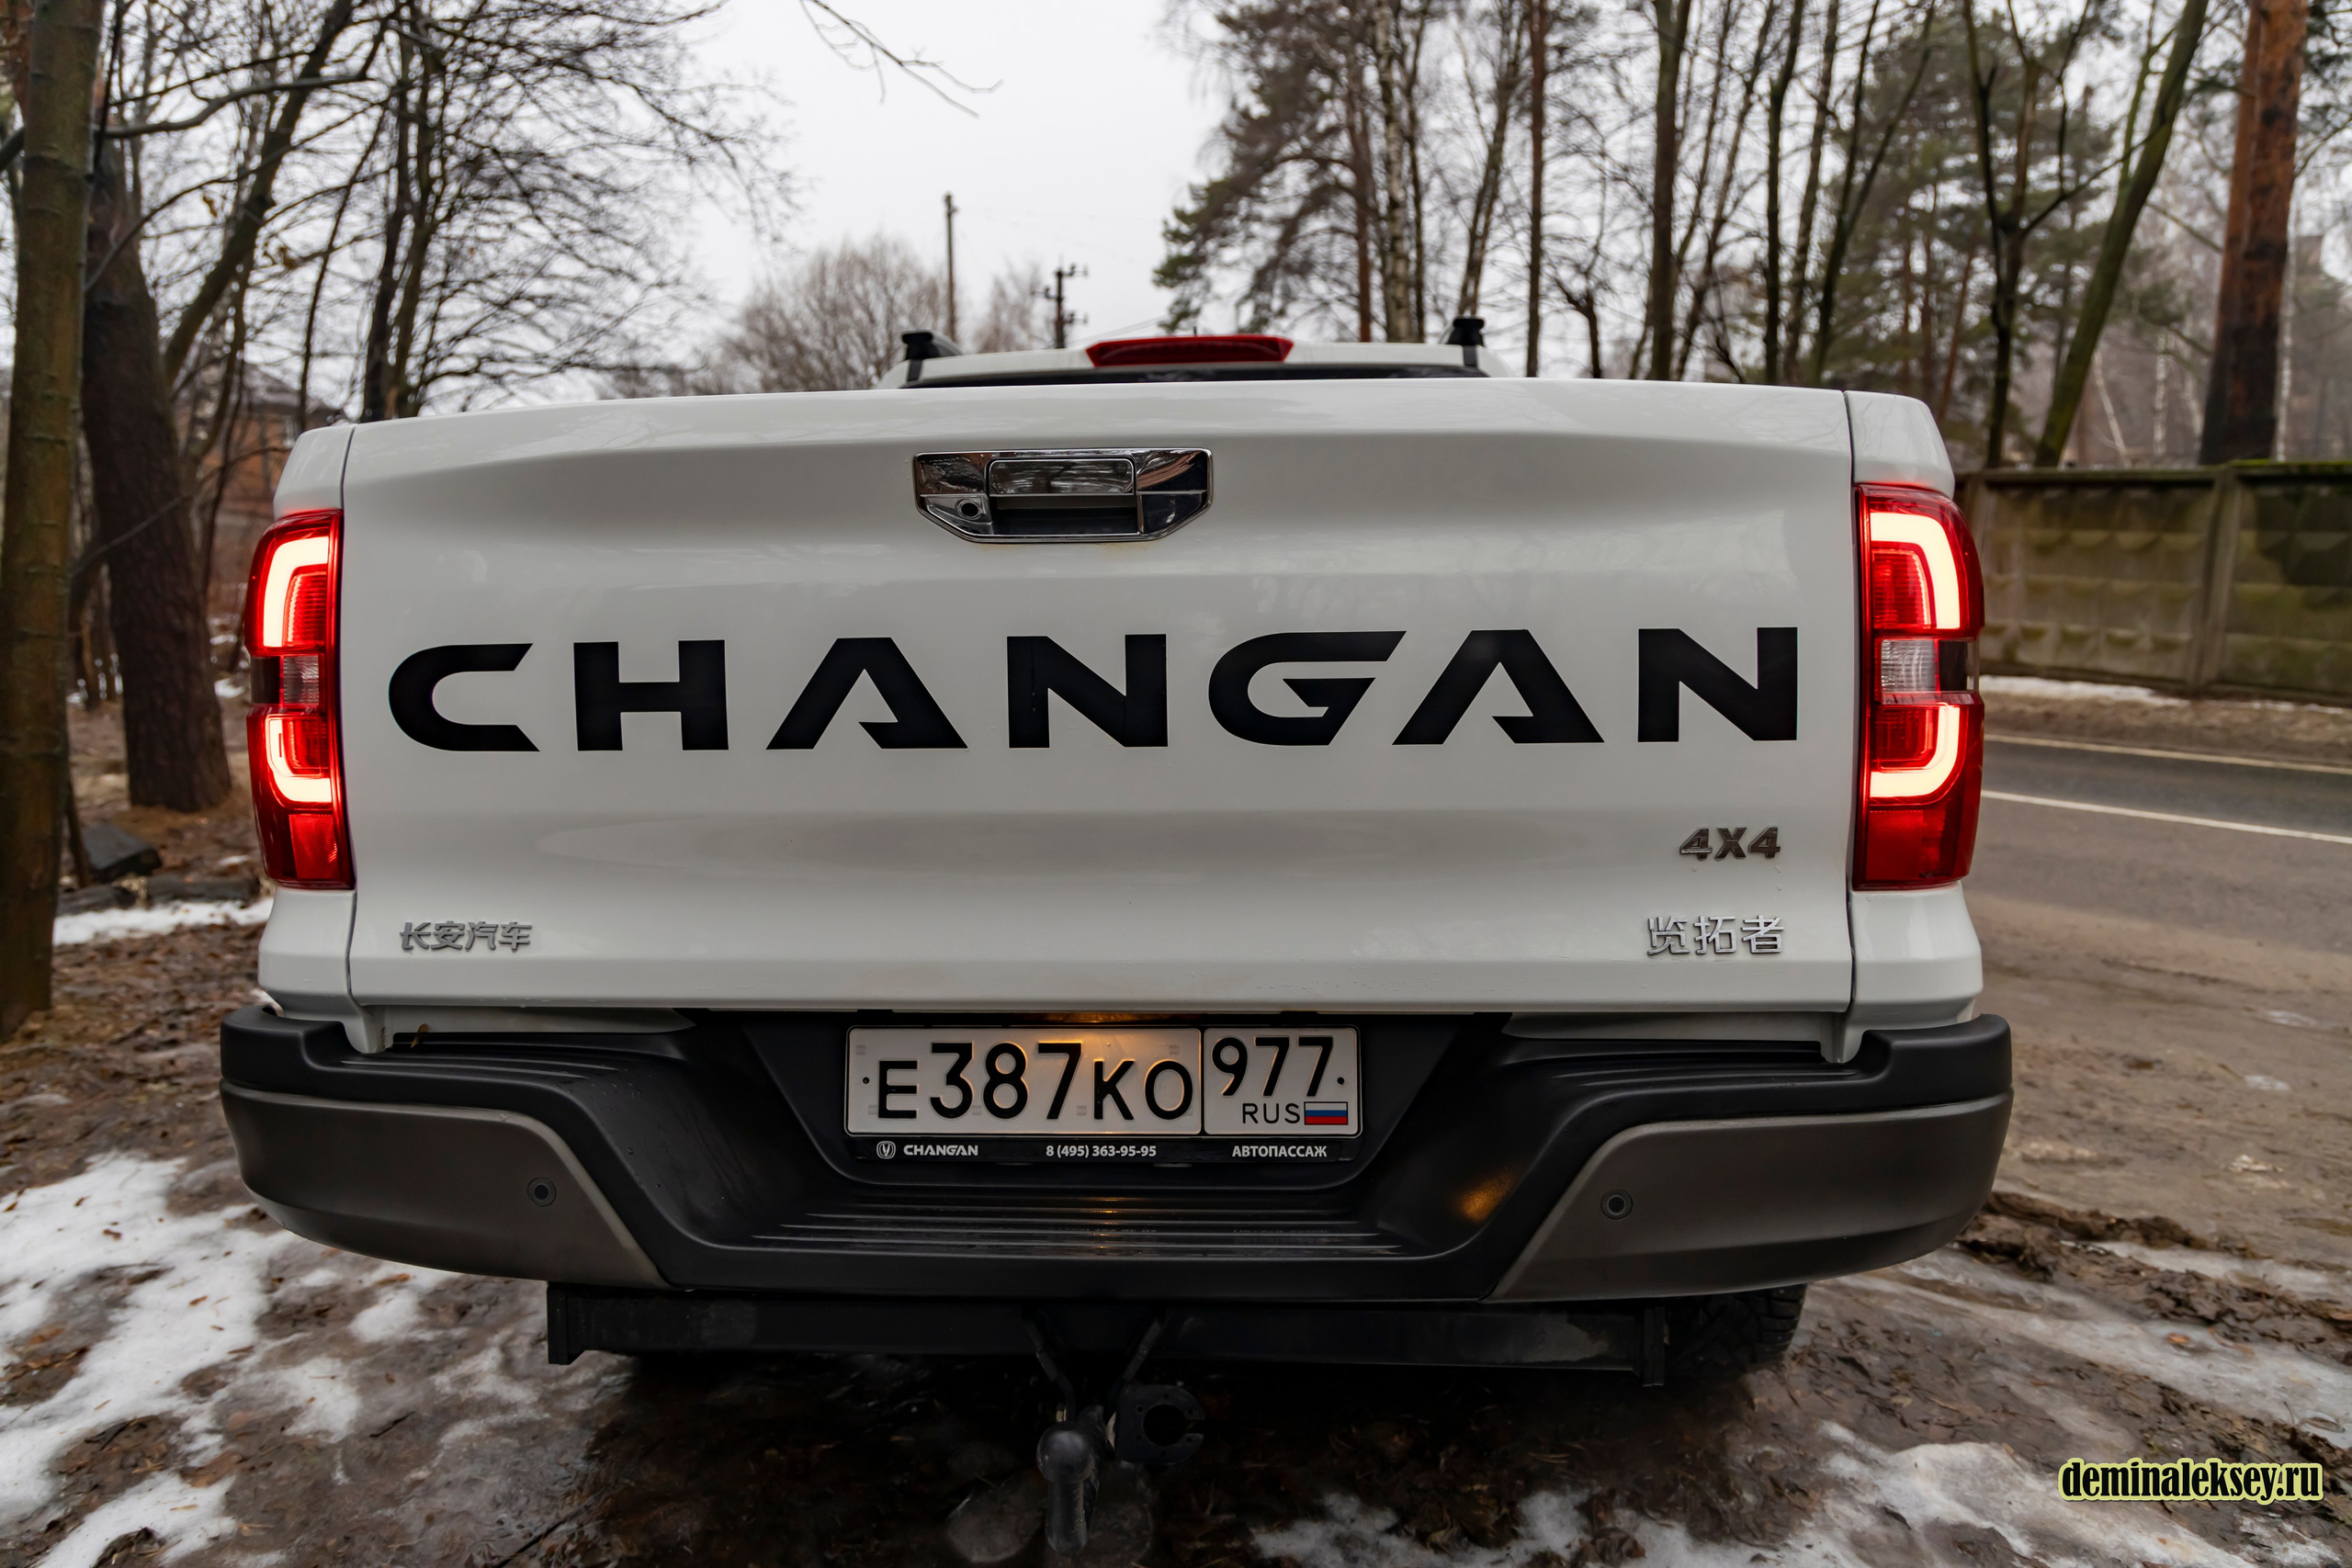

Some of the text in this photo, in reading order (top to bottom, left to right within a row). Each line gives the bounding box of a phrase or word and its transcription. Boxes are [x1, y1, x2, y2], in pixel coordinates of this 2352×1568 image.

[388, 627, 1798, 752] CHANGAN
[1679, 827, 1781, 861] 4X4
[399, 920, 533, 952] 长安汽车
[1647, 915, 1785, 956] 览拓者
[1211, 1035, 1334, 1097] 977
[1241, 1102, 1301, 1124] RUS
[903, 1145, 978, 1156] CHANGAN
[1046, 1145, 1158, 1158] 8 (495) 363-95-95
[1232, 1145, 1328, 1157] АВТОПАССАЖ
